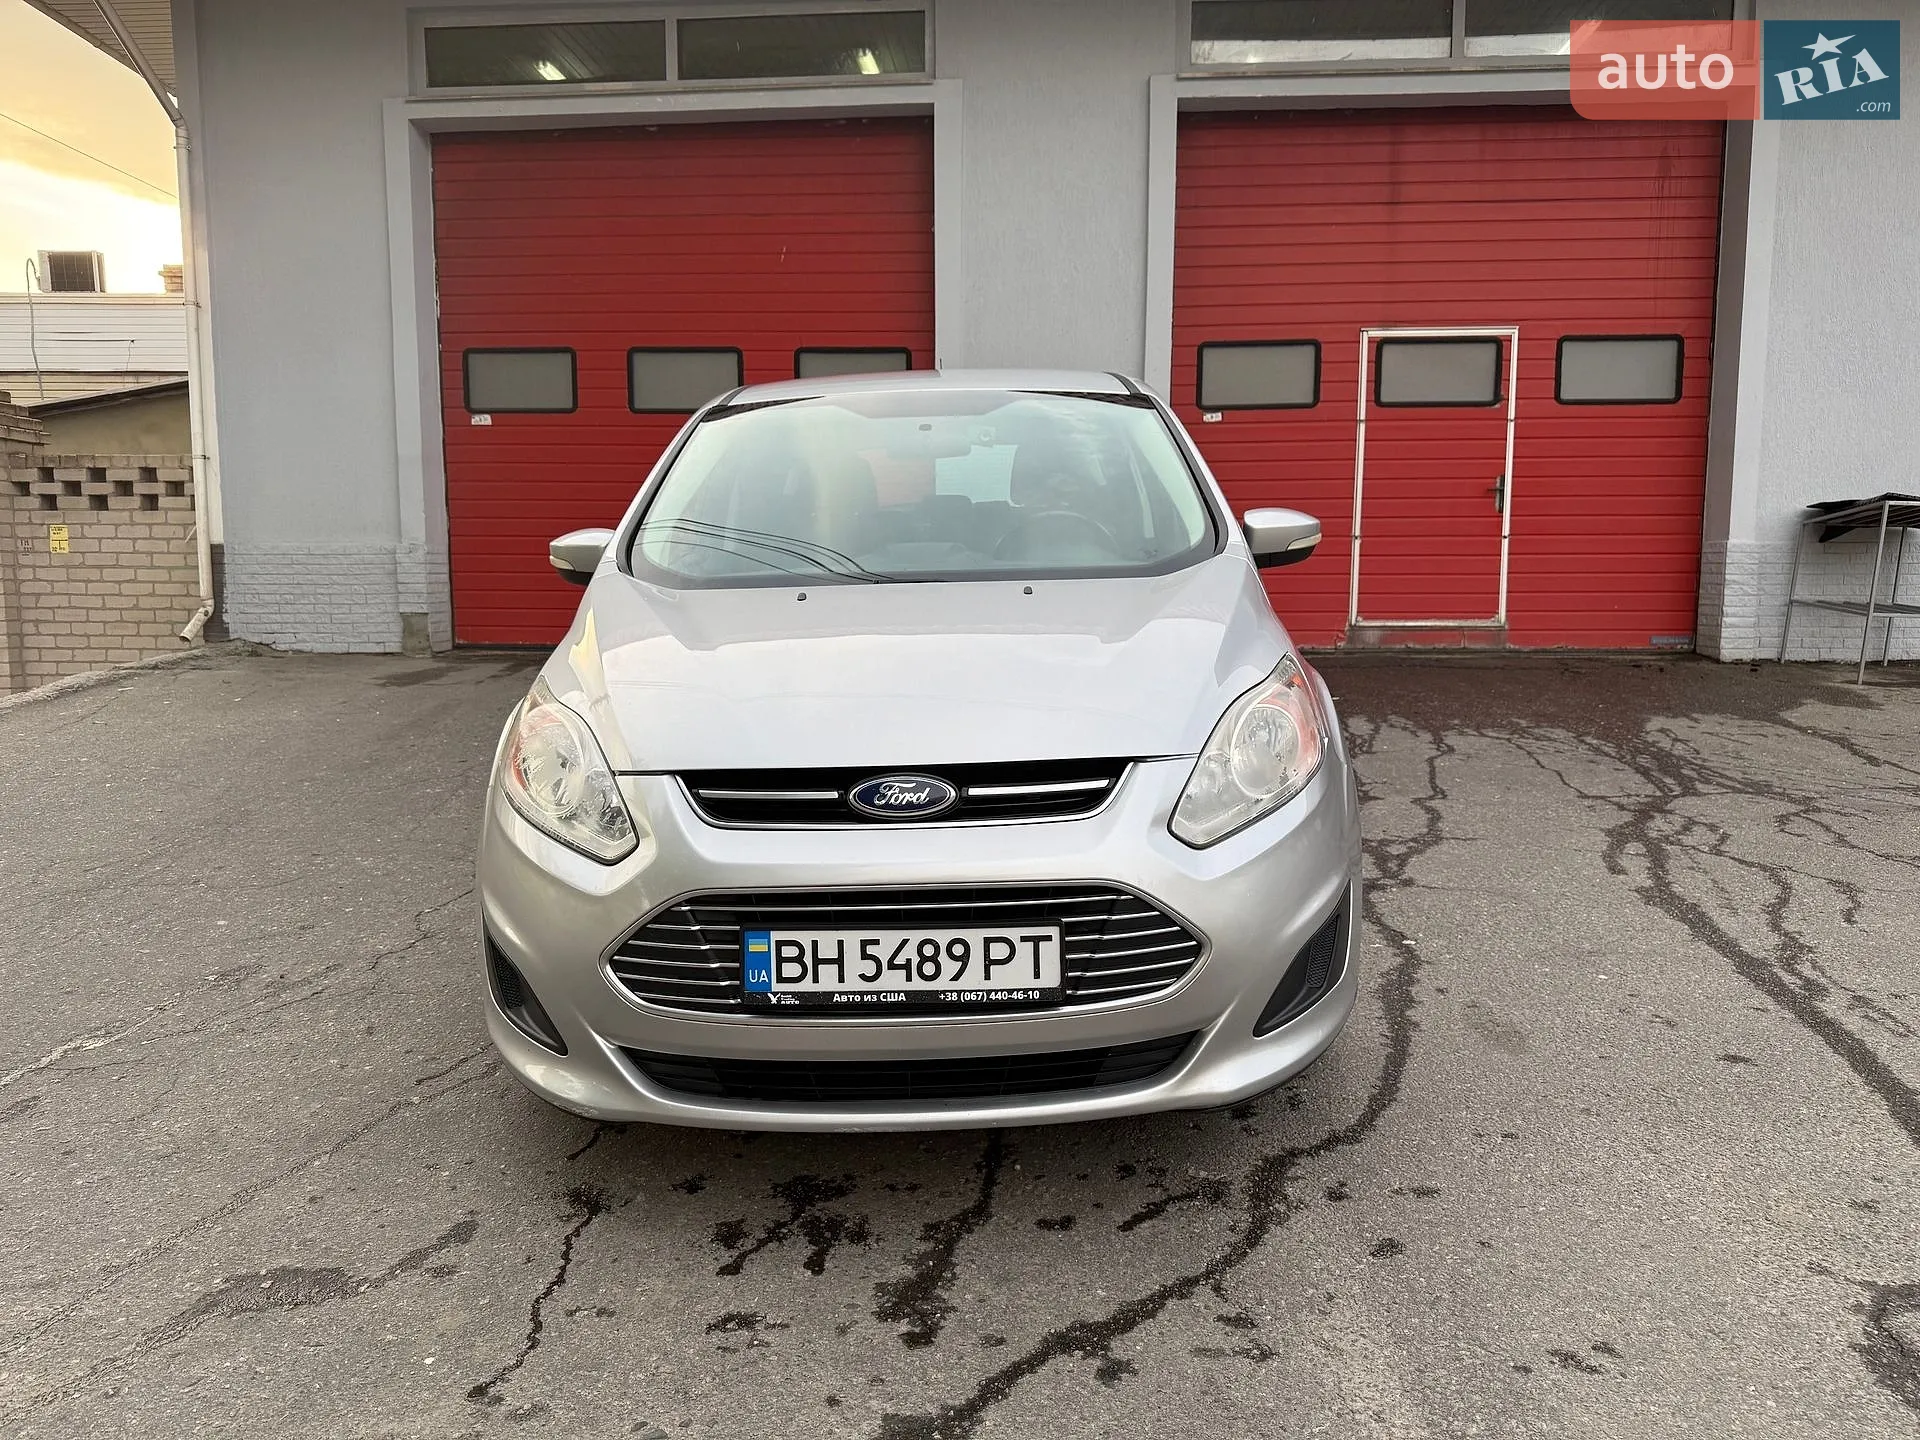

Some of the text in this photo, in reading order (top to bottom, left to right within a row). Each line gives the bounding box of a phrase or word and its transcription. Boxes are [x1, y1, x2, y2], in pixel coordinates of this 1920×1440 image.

[873, 781, 931, 805] Ford
[774, 934, 1053, 984] BH 5489 PT
[748, 969, 769, 983] UA
[832, 992, 907, 1002] Авто из США
[939, 990, 1040, 1003] +38 (067) 440-46-10
